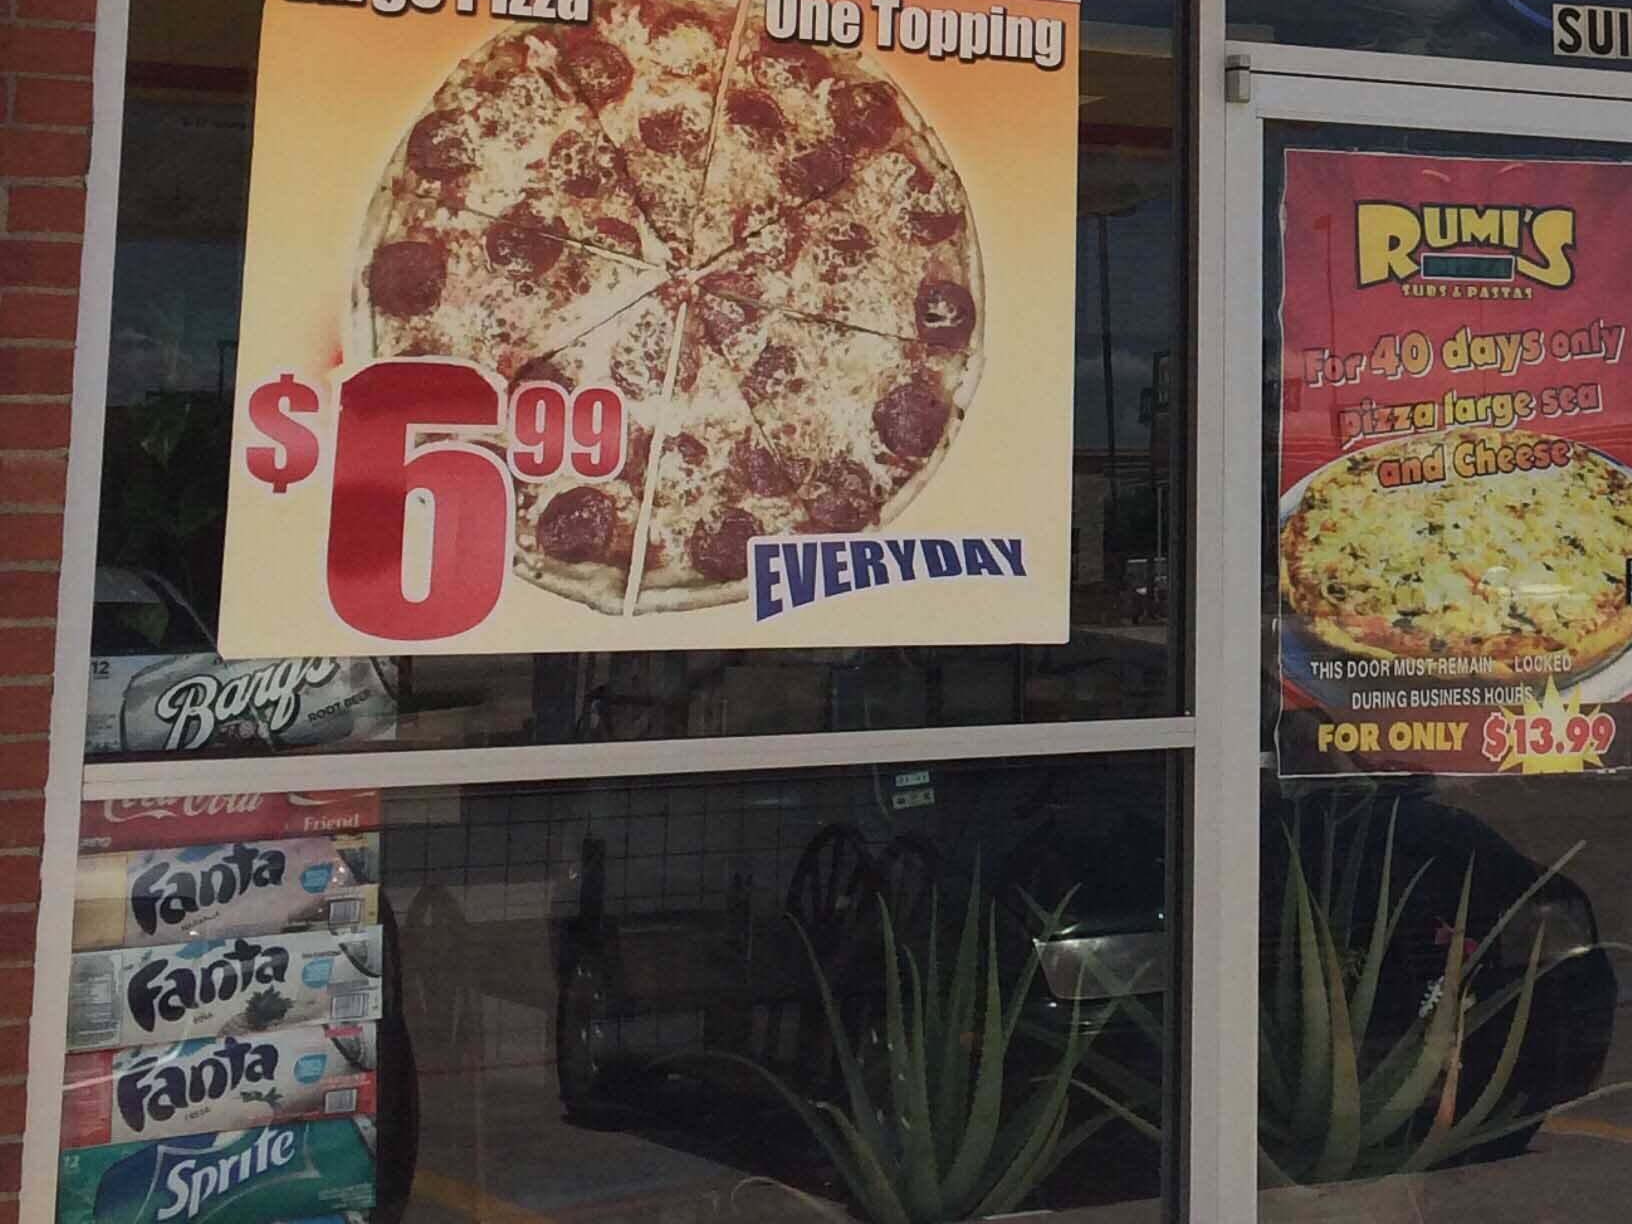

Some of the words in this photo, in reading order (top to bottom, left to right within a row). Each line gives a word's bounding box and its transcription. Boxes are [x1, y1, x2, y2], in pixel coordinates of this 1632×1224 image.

[1355, 200, 1577, 290] RUMI'S
[1466, 285, 1533, 299] PASTAS
[1302, 348, 1367, 387] For
[1370, 331, 1432, 376] 40
[1440, 325, 1545, 376] days
[1550, 319, 1626, 363] only
[1339, 398, 1439, 449] pizza
[1442, 389, 1536, 429] large
[1377, 442, 1446, 487] and
[1452, 438, 1570, 478] Cheese
[754, 538, 1028, 622] EVERYDAY
[1310, 660, 1343, 680] THIS
[1346, 659, 1390, 679] DOOR
[1394, 657, 1433, 677] MUST
[1437, 655, 1493, 676] REMAIN
[1514, 655, 1572, 674] LOCKED
[1352, 690, 1408, 710] DURING
[1410, 687, 1481, 707] BUSINESS
[1484, 684, 1534, 705] HOURS
[307, 702, 341, 723] ROOT
[1317, 722, 1382, 752] FOR
[1387, 721, 1470, 752] ONLY
[1482, 711, 1617, 762] $13.99
[303, 812, 360, 832] Friend
[131, 841, 286, 936] Fanta
[127, 937, 291, 1032] Fanta
[117, 1035, 280, 1133] Fanta
[157, 1125, 298, 1223] Sprite
